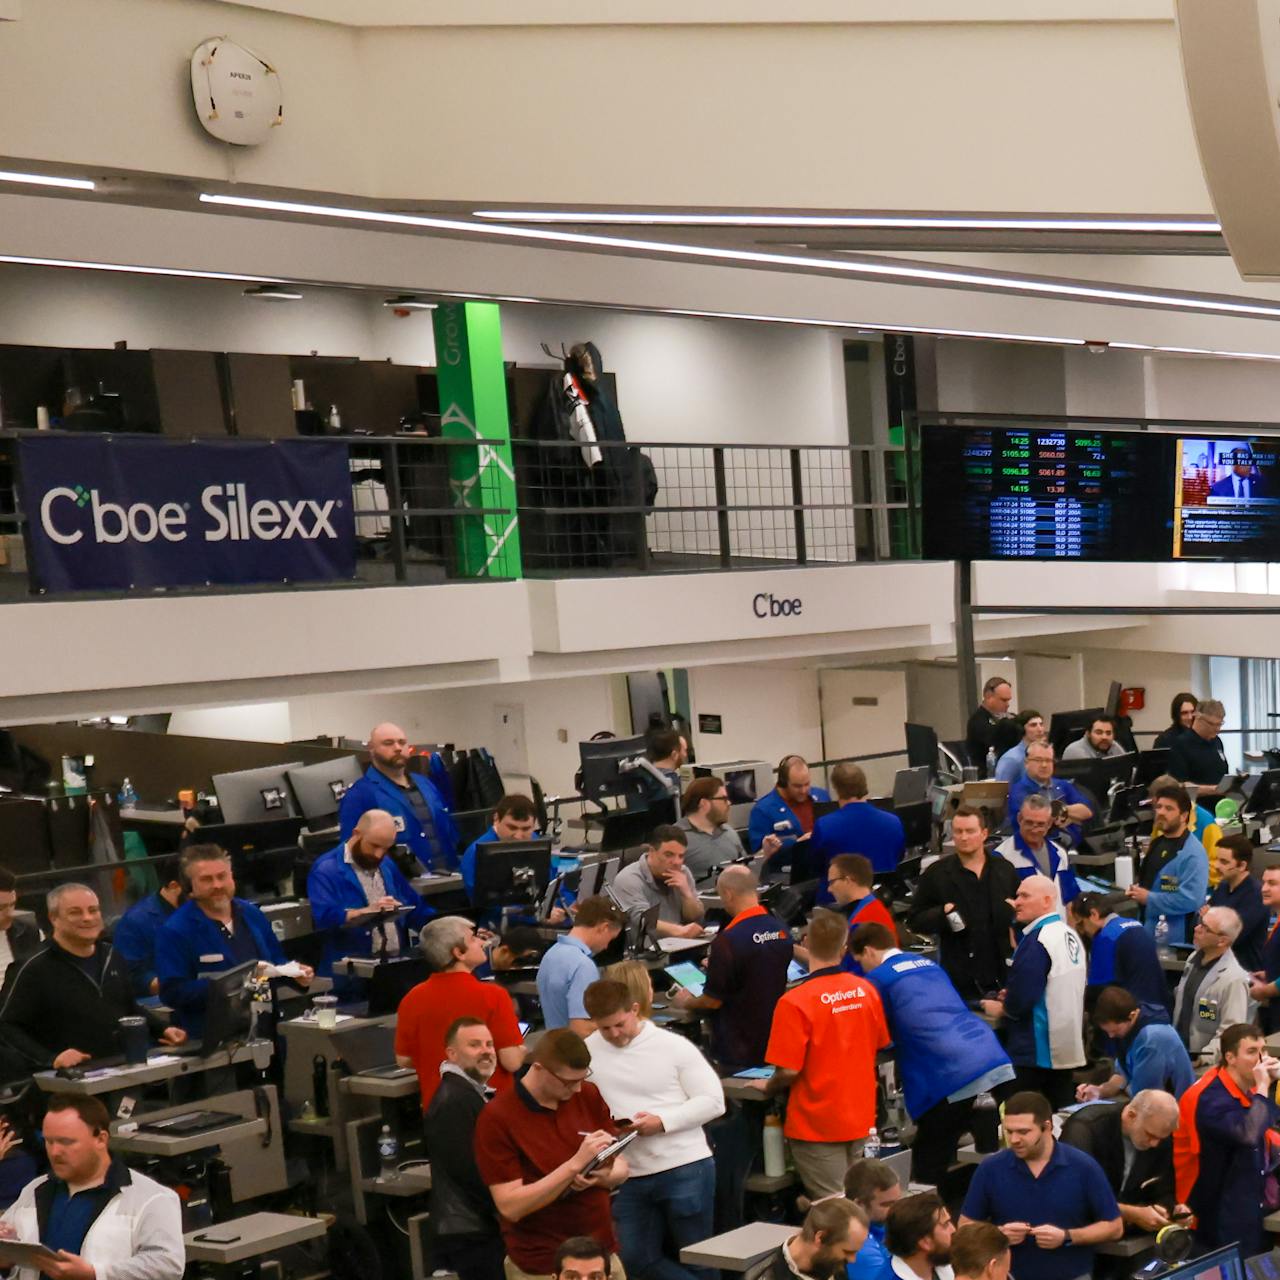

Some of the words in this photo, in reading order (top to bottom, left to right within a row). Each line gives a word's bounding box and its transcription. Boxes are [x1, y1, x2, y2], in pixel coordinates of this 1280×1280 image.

[41, 486, 188, 545] Cboe
[201, 483, 338, 541] Silexx
[753, 593, 802, 618] Cboe
[753, 931, 780, 943] Optiver
[820, 990, 857, 1005] Optiver
